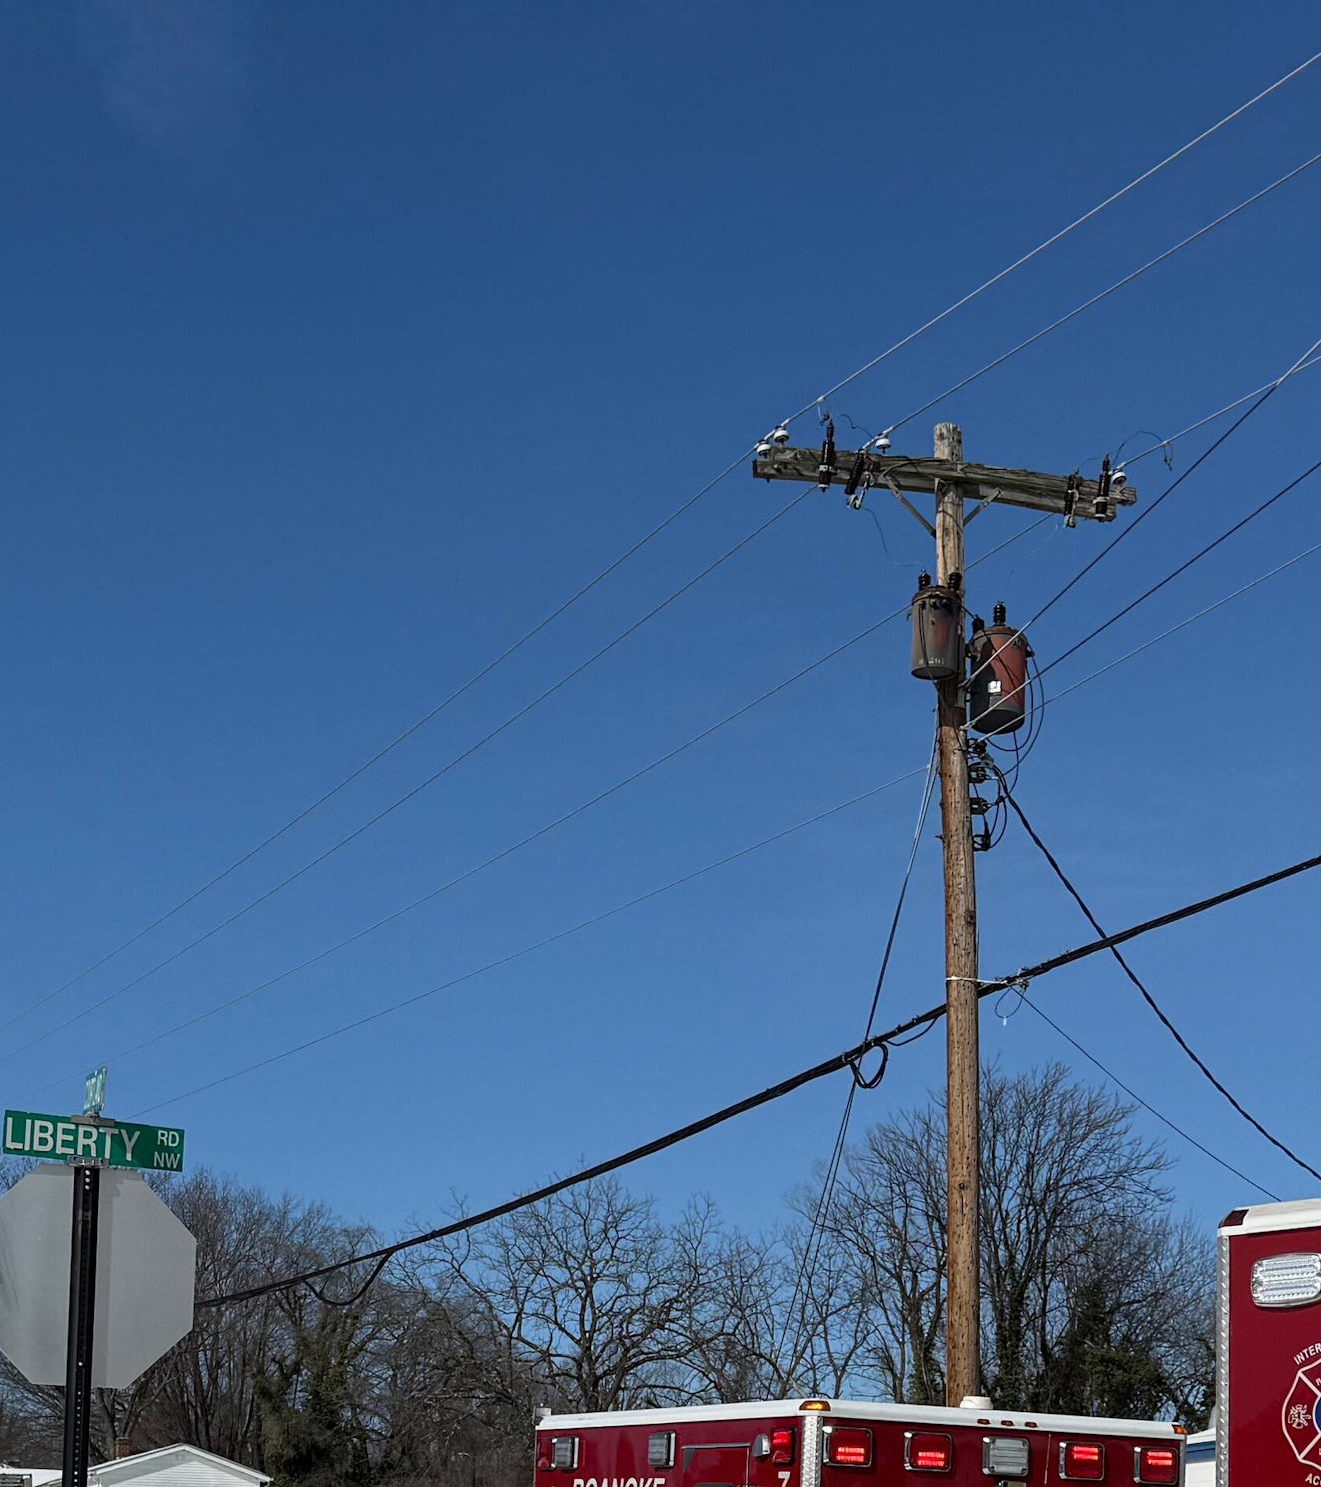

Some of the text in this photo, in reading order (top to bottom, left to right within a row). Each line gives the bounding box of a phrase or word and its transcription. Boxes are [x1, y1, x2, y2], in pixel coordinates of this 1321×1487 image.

[5, 1117, 140, 1161] LIBERTY
[157, 1130, 180, 1147] RD
[153, 1151, 181, 1169] NW
